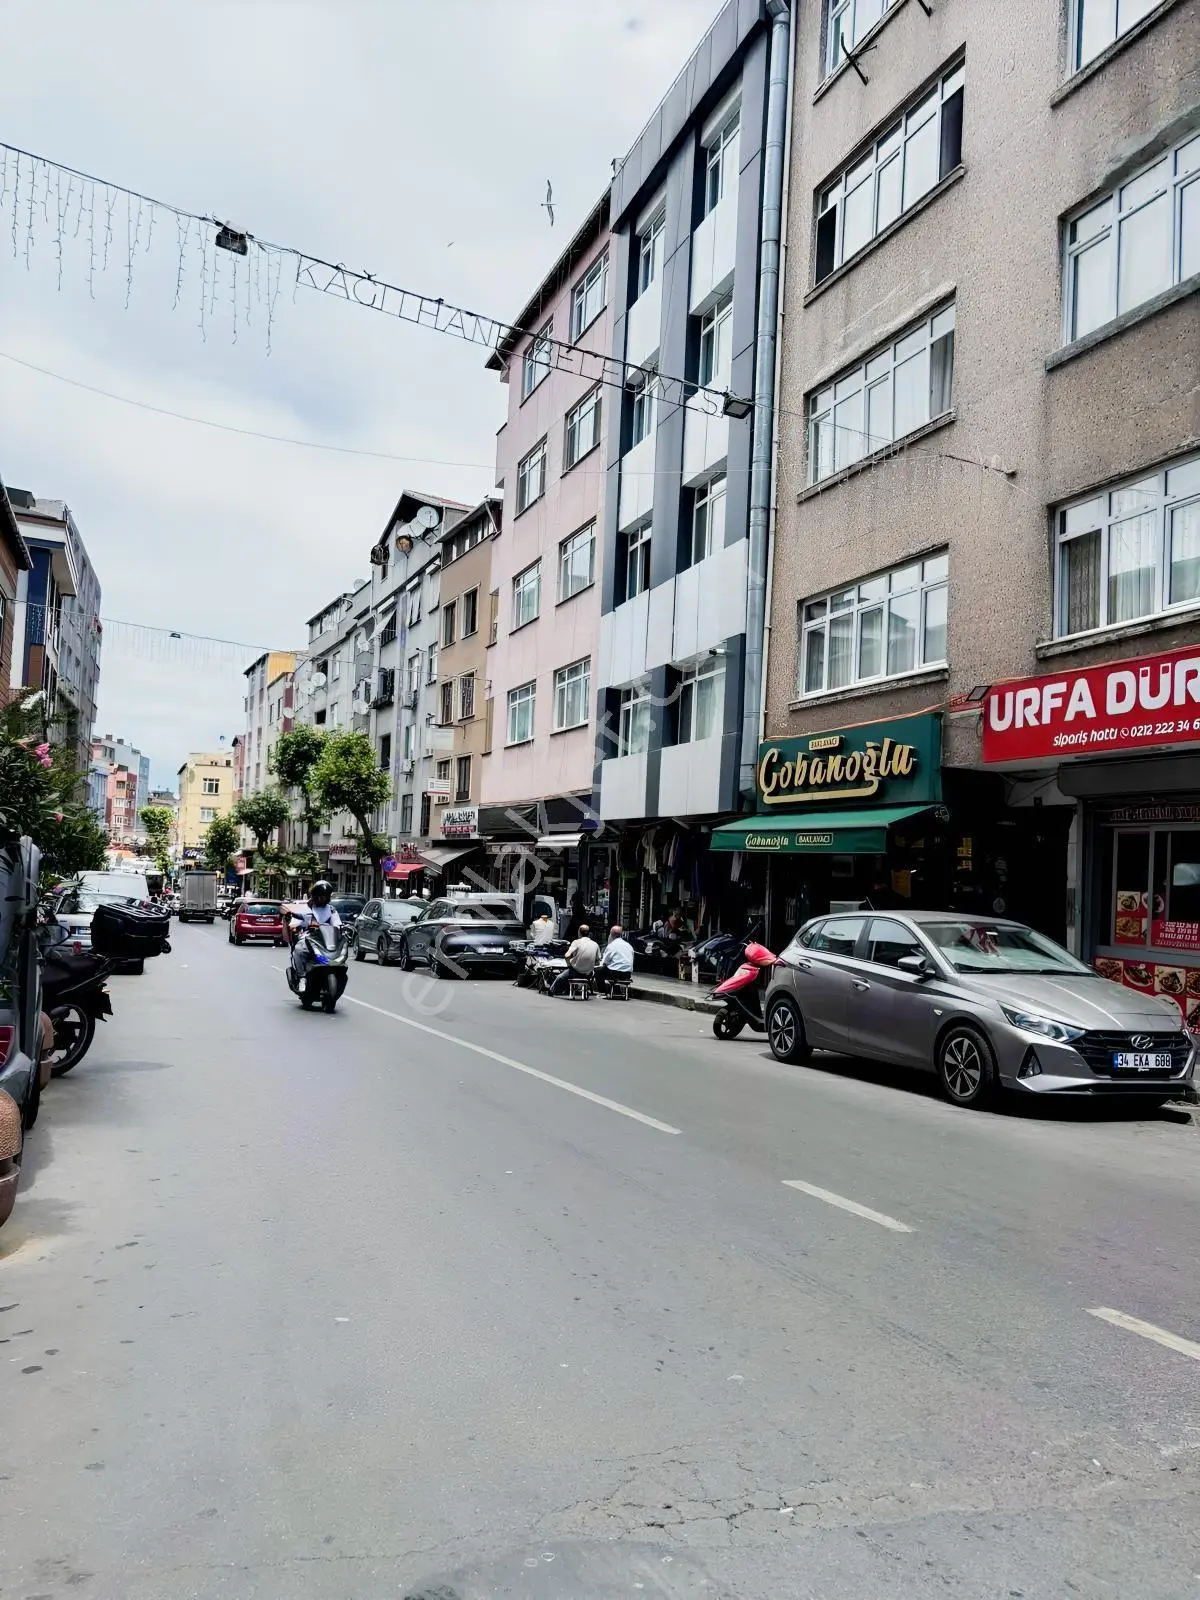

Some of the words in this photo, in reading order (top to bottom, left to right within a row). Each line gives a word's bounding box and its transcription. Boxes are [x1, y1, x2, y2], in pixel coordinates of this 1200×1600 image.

[990, 678, 1097, 732] URFA
[1131, 724, 1153, 738] 0212
[1154, 722, 1175, 735] 222
[1177, 720, 1190, 732] 34
[1118, 1054, 1129, 1066] 34
[1133, 1054, 1149, 1066] EKA
